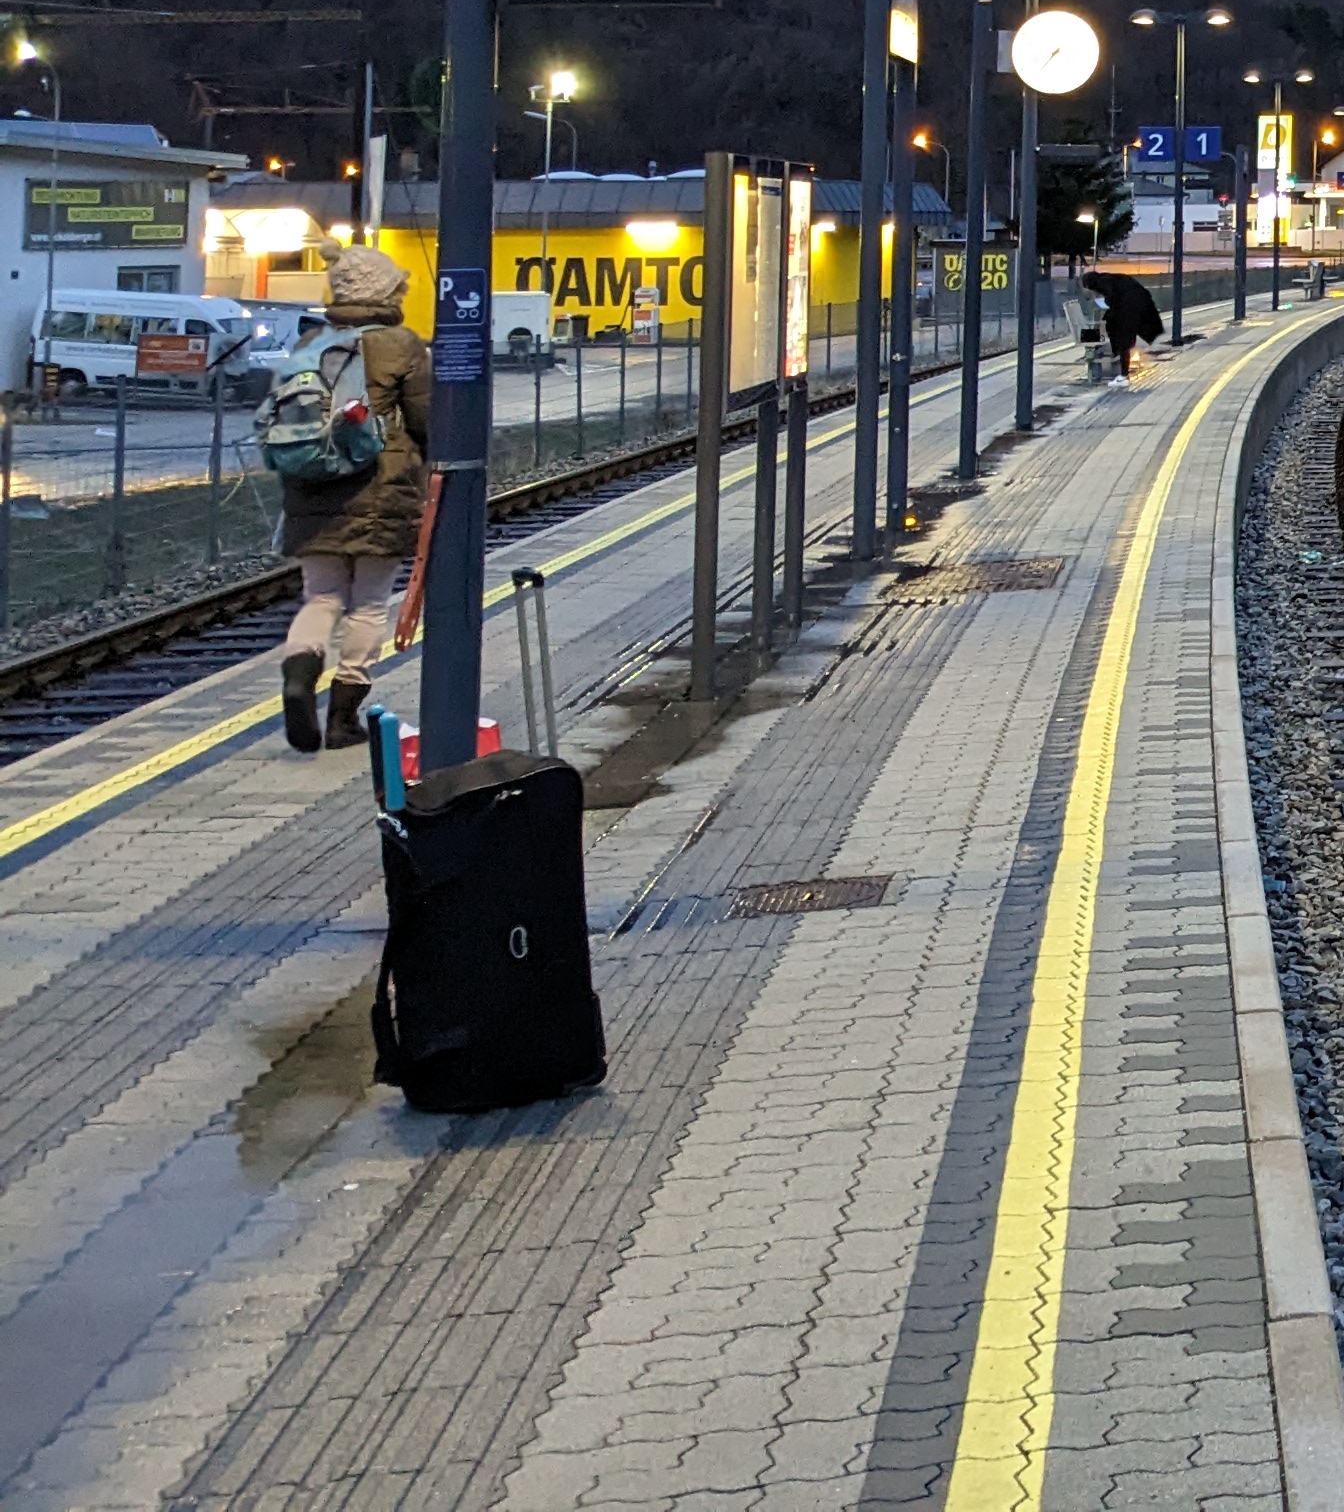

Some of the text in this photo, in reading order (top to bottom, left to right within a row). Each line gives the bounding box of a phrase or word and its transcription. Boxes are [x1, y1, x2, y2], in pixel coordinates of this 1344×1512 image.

[1147, 133, 1164, 156] 2
[1196, 132, 1208, 156] 1
[439, 276, 454, 301] P
